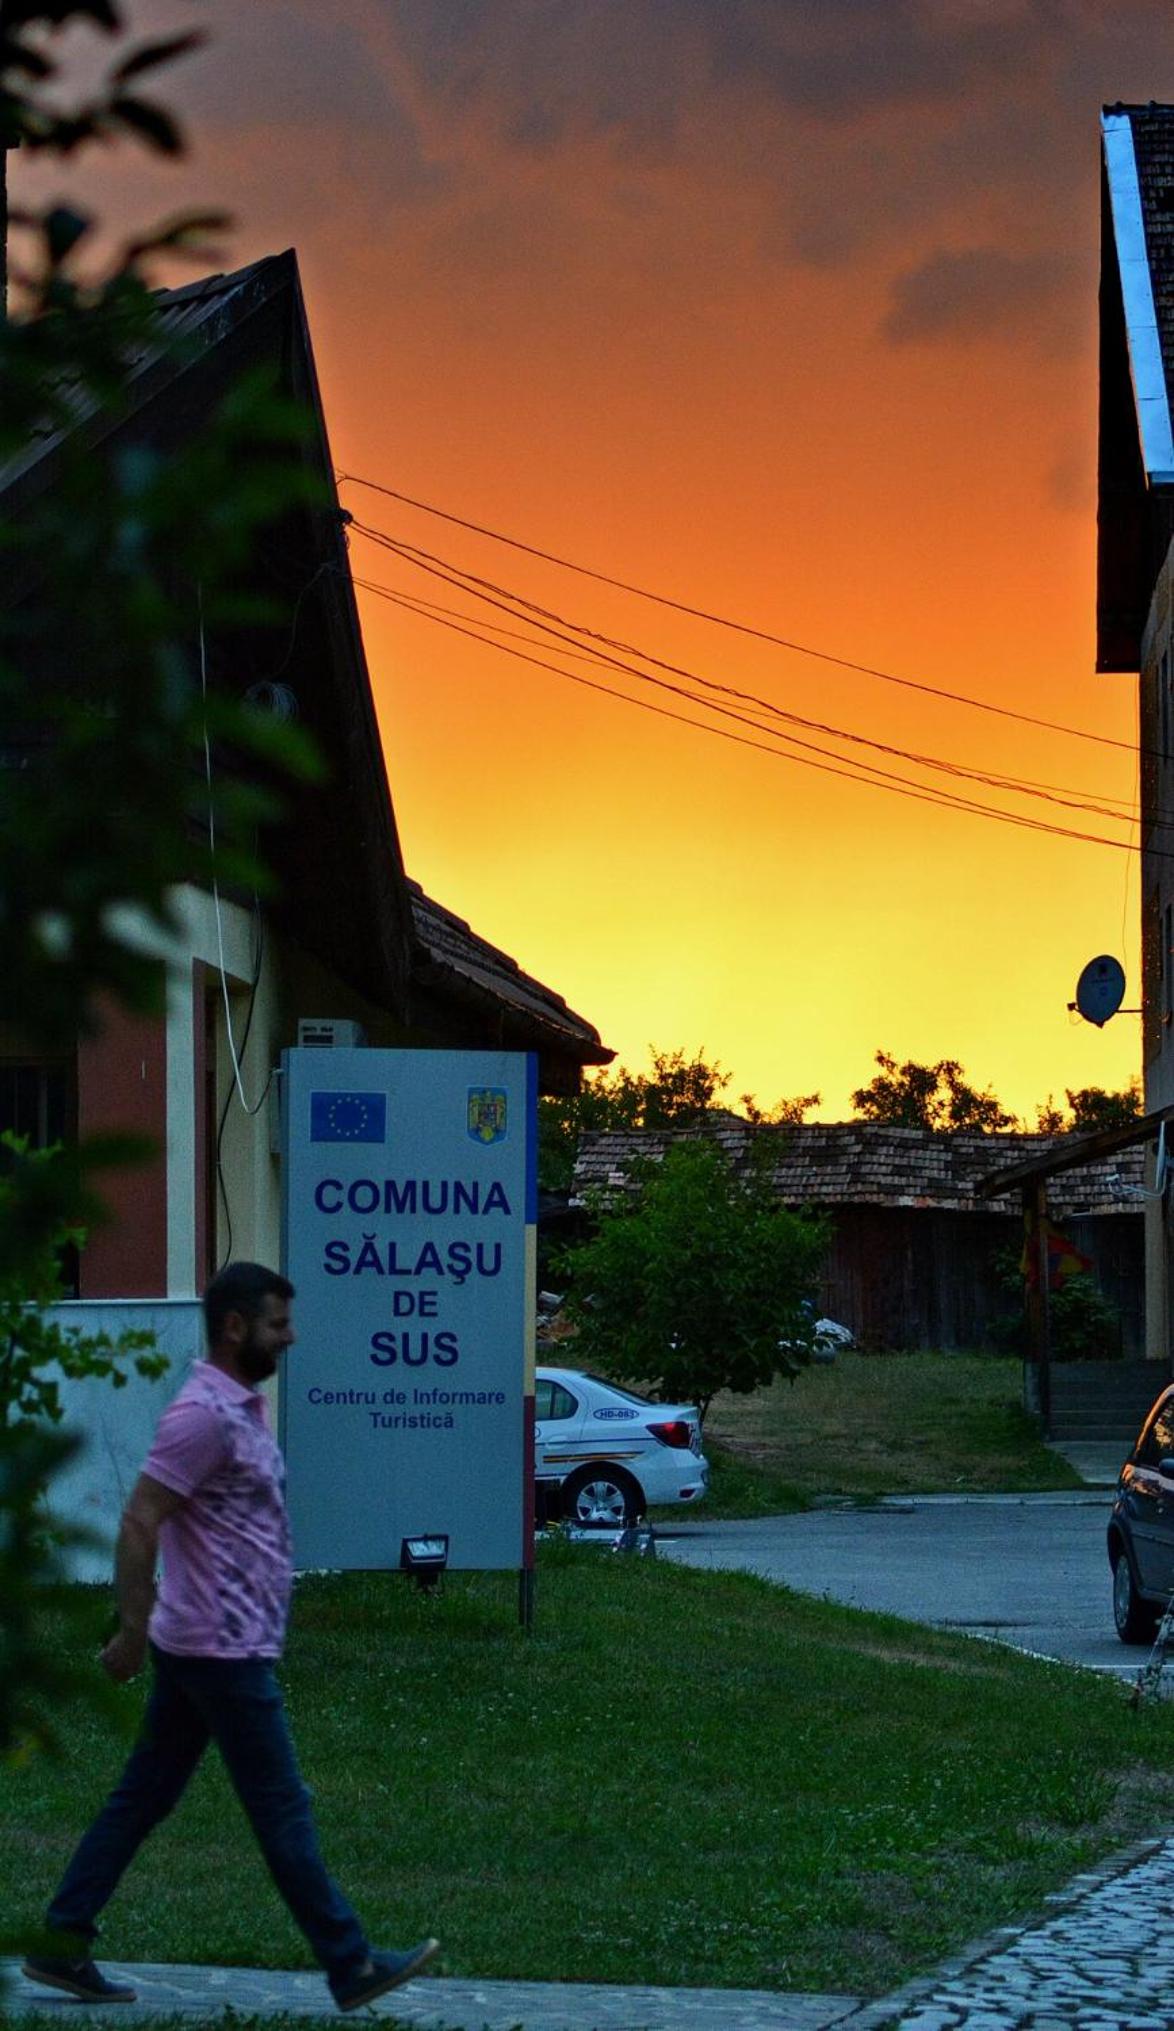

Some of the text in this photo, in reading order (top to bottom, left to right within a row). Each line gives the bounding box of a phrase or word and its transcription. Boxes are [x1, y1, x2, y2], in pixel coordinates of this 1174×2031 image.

[314, 1178, 511, 1215] COMUNA
[392, 1290, 438, 1318] DE
[370, 1331, 459, 1367] SUS
[307, 1387, 506, 1405] Centru de Informare
[369, 1411, 454, 1429] Turistică
